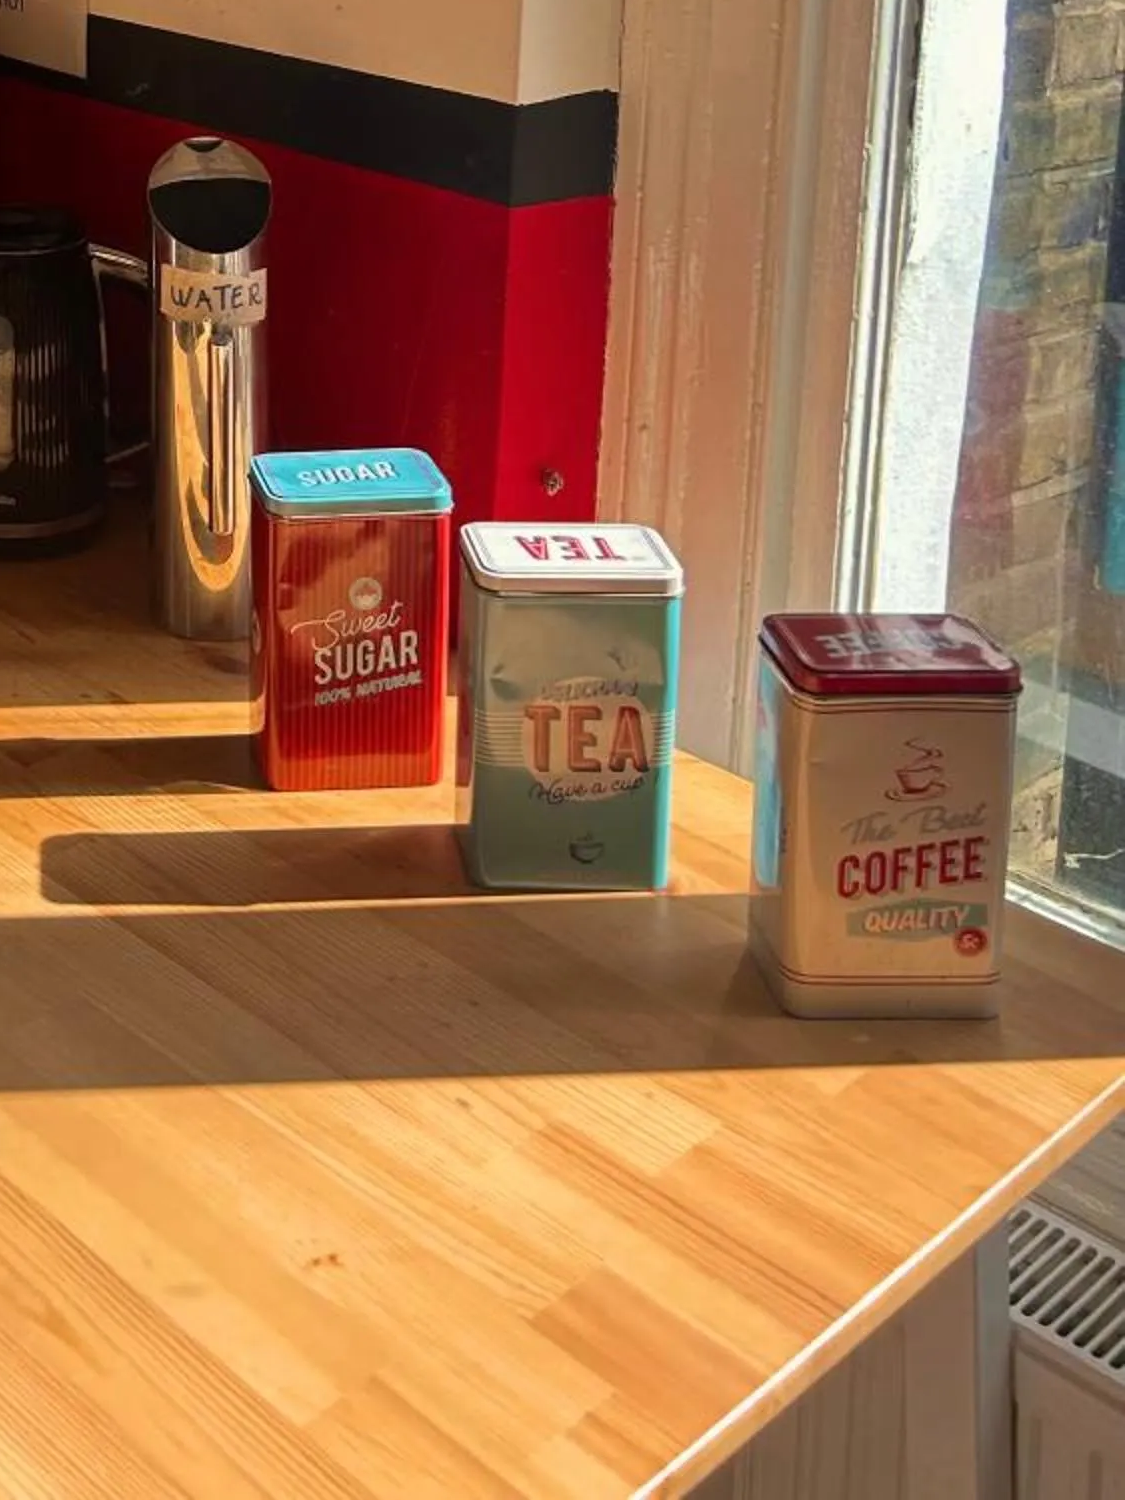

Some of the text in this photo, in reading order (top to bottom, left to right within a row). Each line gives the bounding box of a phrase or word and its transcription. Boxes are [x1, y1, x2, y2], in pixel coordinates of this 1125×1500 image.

[170, 282, 263, 312] WATER
[297, 460, 398, 488] SUGAR
[514, 534, 627, 562] TEA
[290, 600, 404, 651] Sweet
[314, 629, 419, 685] SUGAR
[355, 669, 422, 698] NATURAL
[525, 705, 651, 773] TEA
[840, 802, 987, 845] The Best
[838, 836, 989, 898] COFFEE
[863, 905, 970, 933] QUALITY
